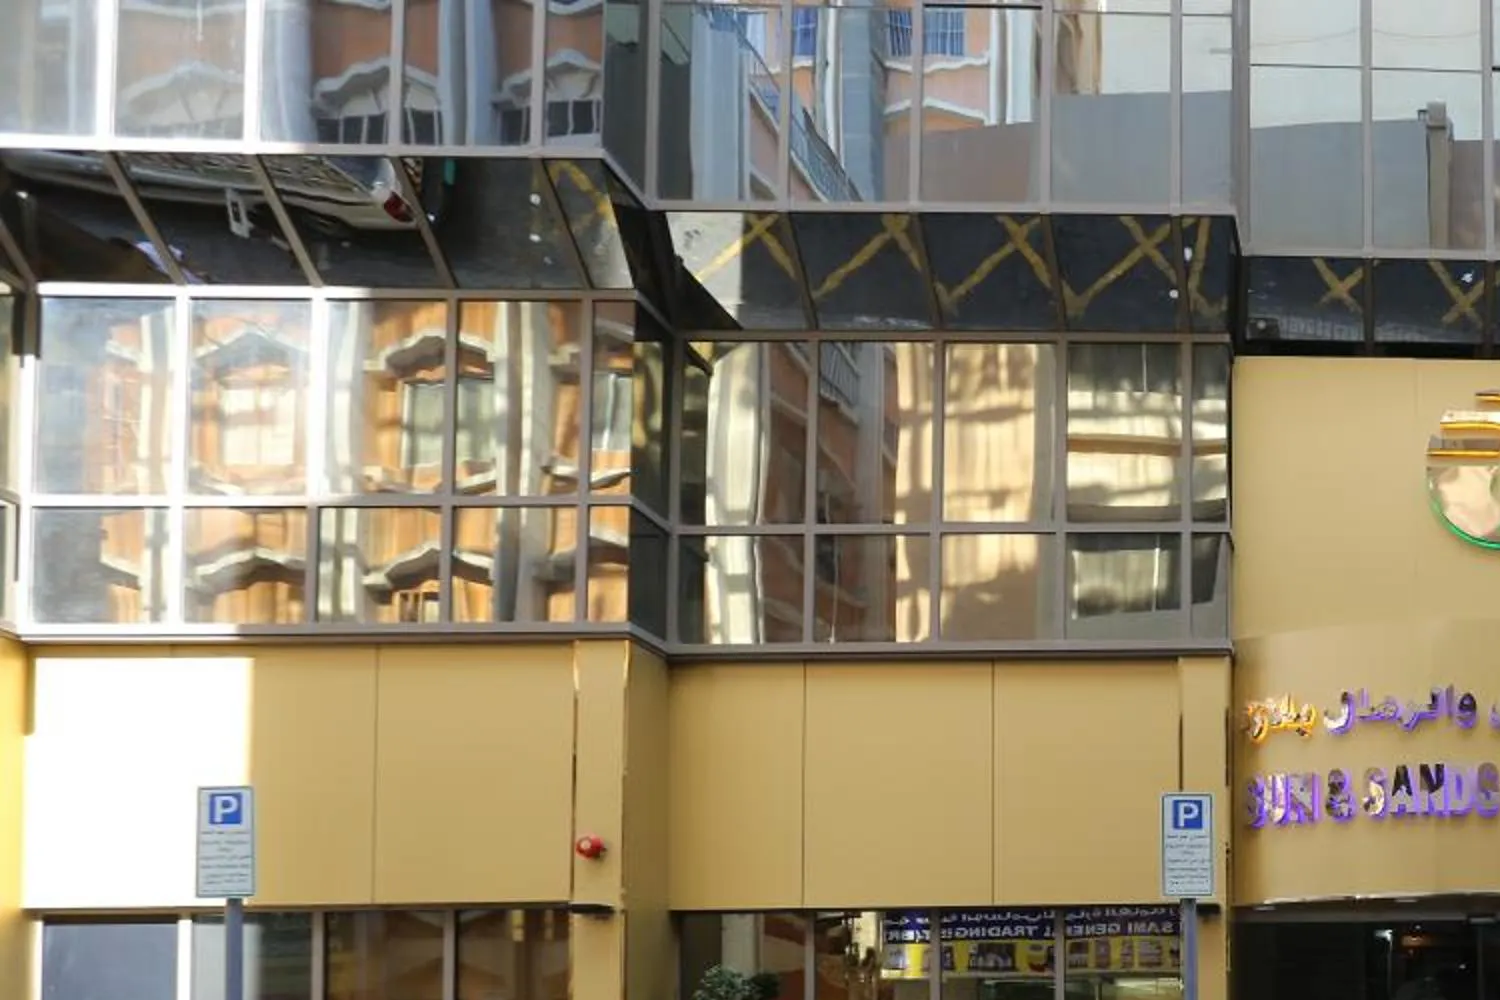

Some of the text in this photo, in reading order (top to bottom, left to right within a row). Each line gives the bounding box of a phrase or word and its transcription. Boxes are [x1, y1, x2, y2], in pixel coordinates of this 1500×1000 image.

[1324, 684, 1477, 735] والرمال
[213, 795, 239, 823] P
[1248, 772, 1321, 828] SUN
[1326, 768, 1354, 822] &
[1363, 761, 1500, 818] SANDS
[1177, 802, 1200, 828] P
